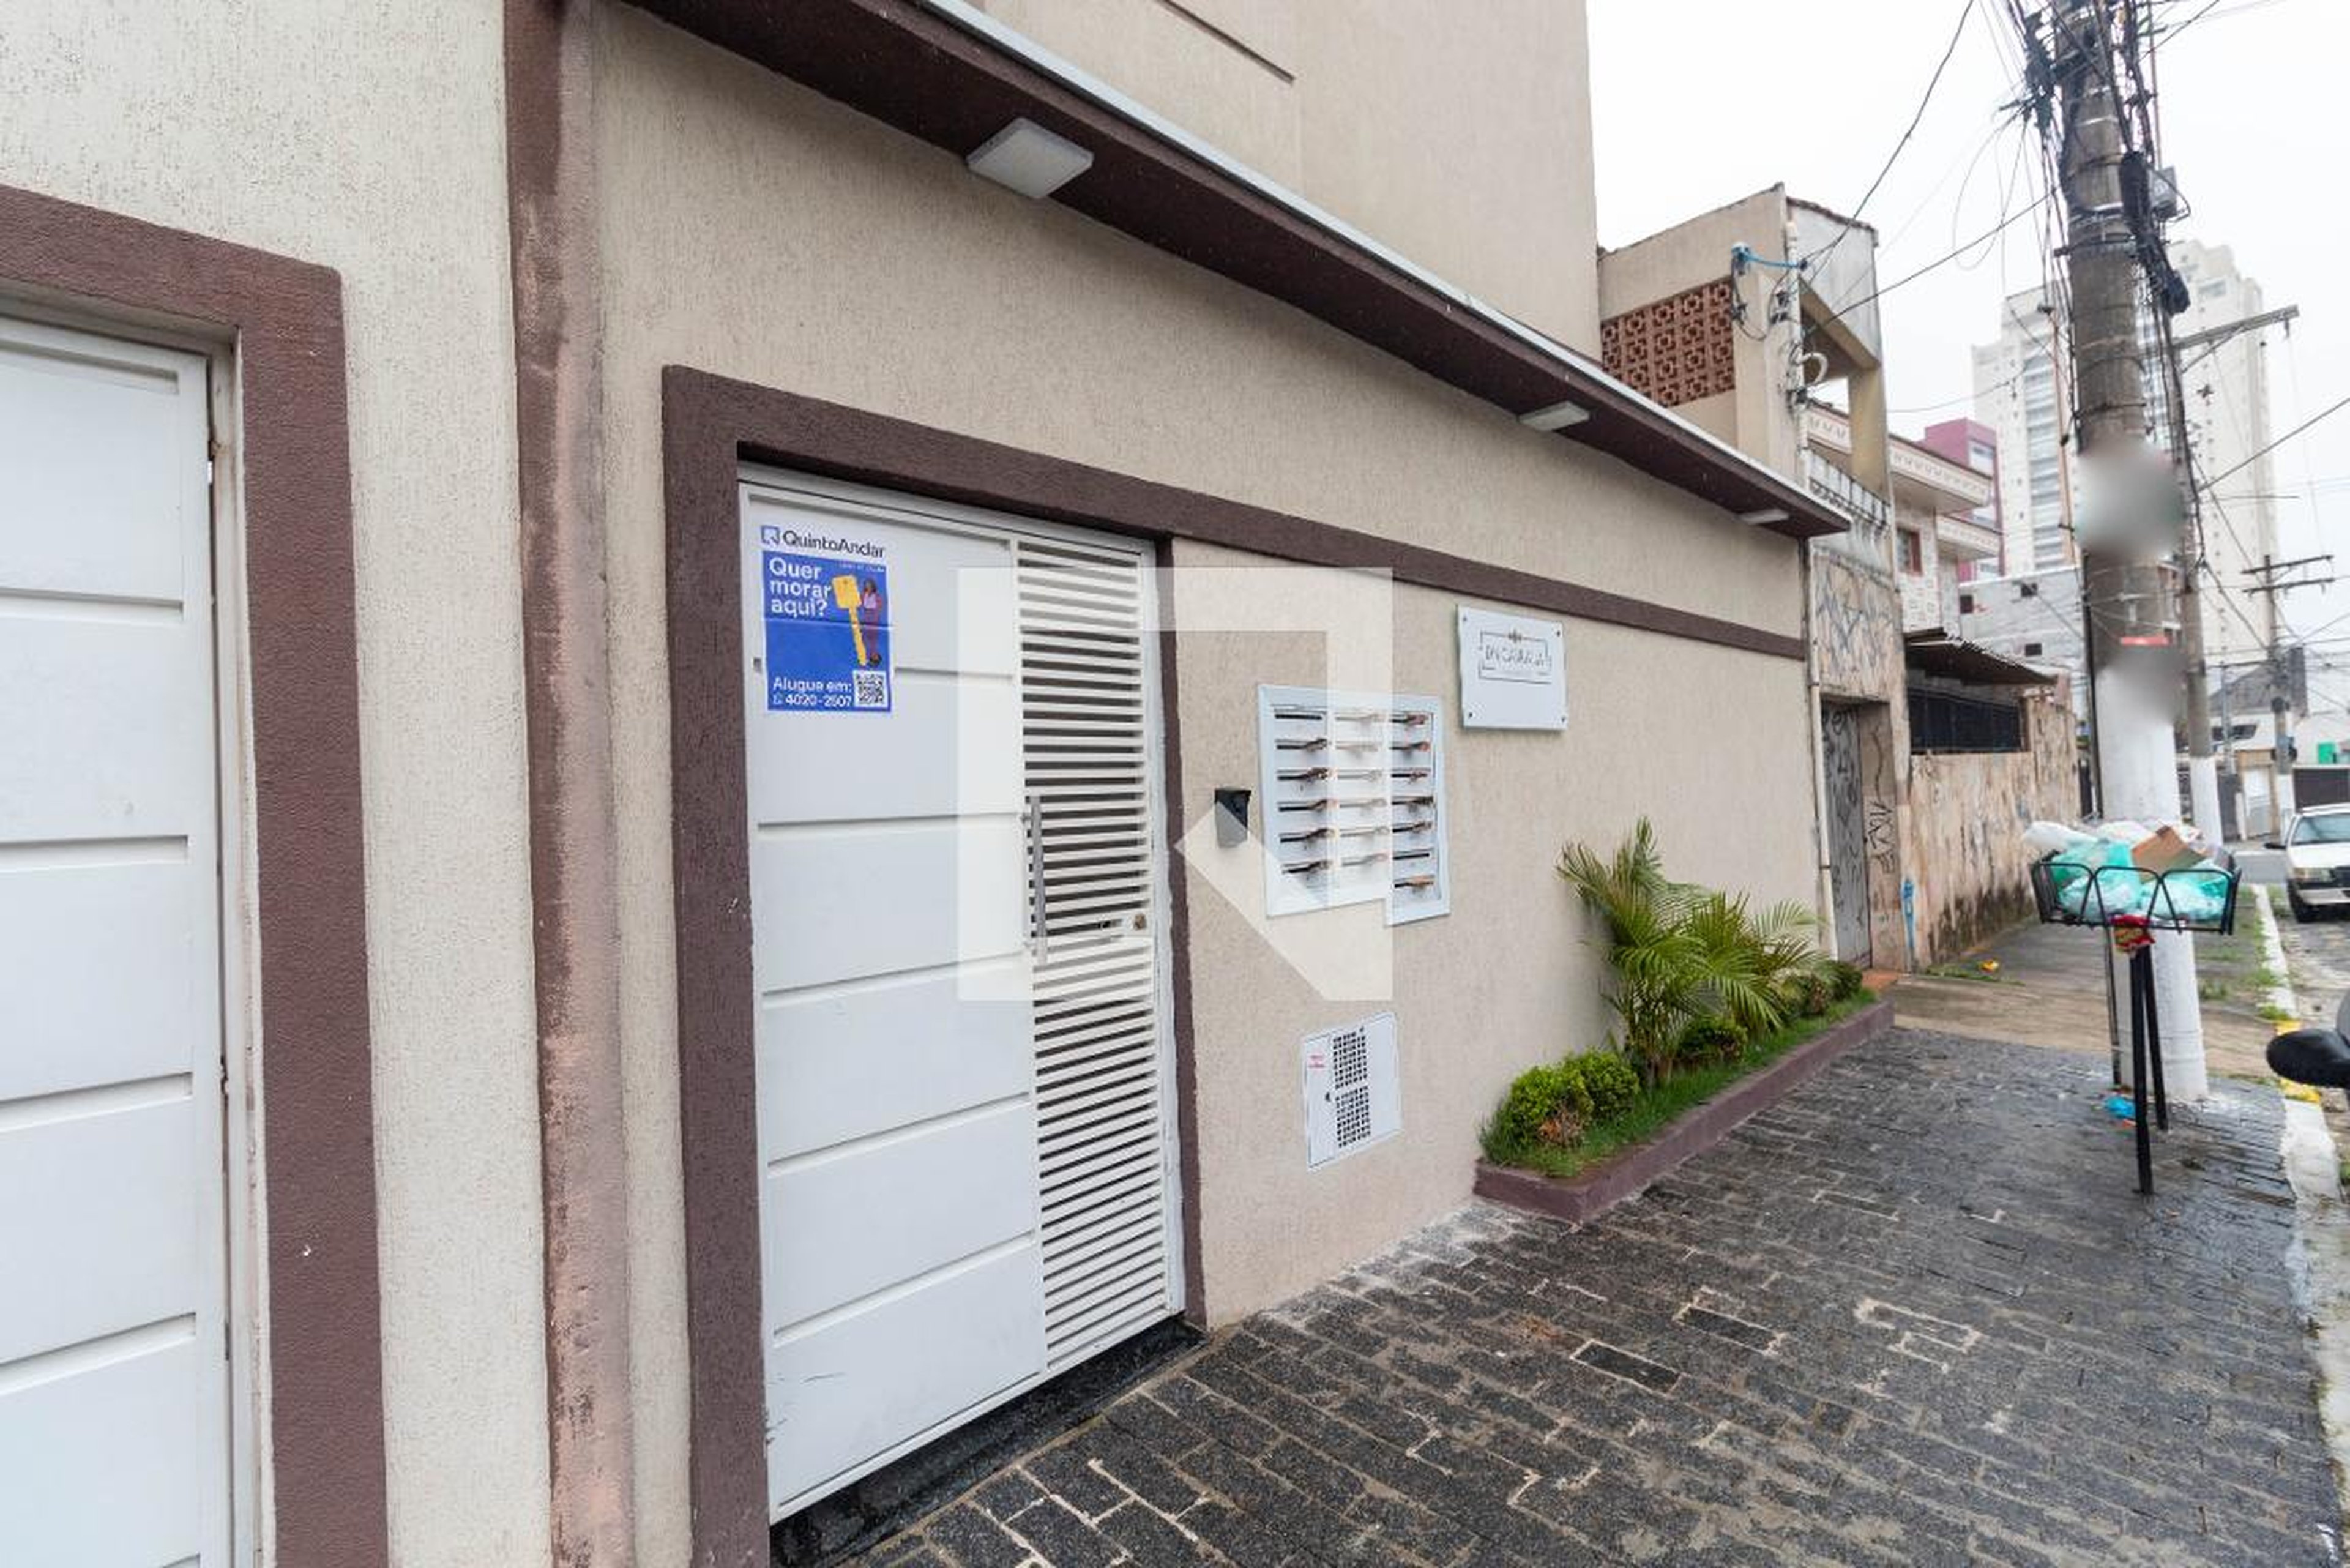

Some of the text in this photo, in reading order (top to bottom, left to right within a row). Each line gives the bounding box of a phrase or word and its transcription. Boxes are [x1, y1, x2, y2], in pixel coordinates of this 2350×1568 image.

[782, 530, 885, 558] QuintoAndar
[769, 557, 822, 580] Quer
[770, 580, 831, 599] morar
[770, 598, 827, 618] aqui?
